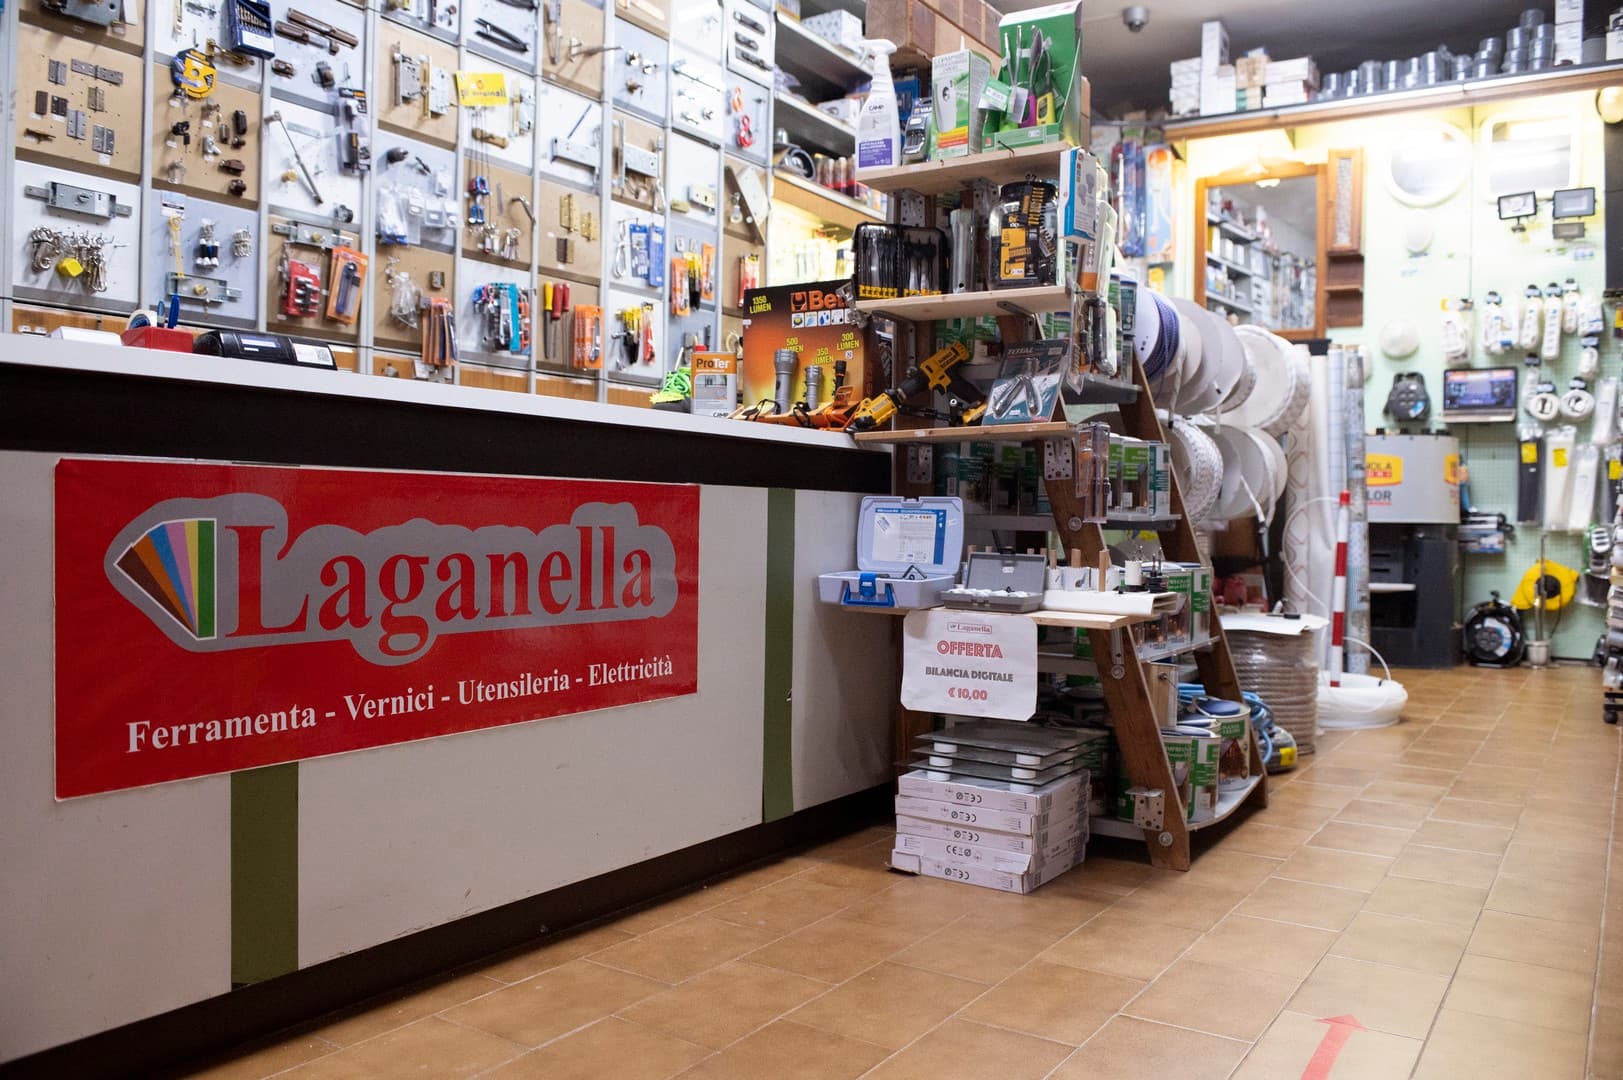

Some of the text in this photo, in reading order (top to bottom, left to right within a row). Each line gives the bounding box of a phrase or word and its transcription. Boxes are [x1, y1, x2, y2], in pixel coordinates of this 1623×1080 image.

[752, 295, 767, 304] 1350
[808, 290, 849, 310] Bet
[749, 303, 772, 314] LUMEN
[786, 337, 799, 345] 500
[841, 332, 854, 341] 300
[785, 343, 804, 353] UMEN
[836, 340, 860, 351] LUMEN
[696, 358, 731, 369] ProTer
[1367, 490, 1392, 501] LOR
[226, 524, 655, 656] Laganella
[936, 640, 1004, 659] OFFERTA
[925, 666, 1014, 682] BILANCIA DIGITALE
[957, 688, 988, 700] 10,00
[126, 704, 317, 754] Ferramenta
[343, 684, 436, 722] Vernici
[457, 668, 571, 707] Utensileria
[588, 655, 674, 687] Elettricità
